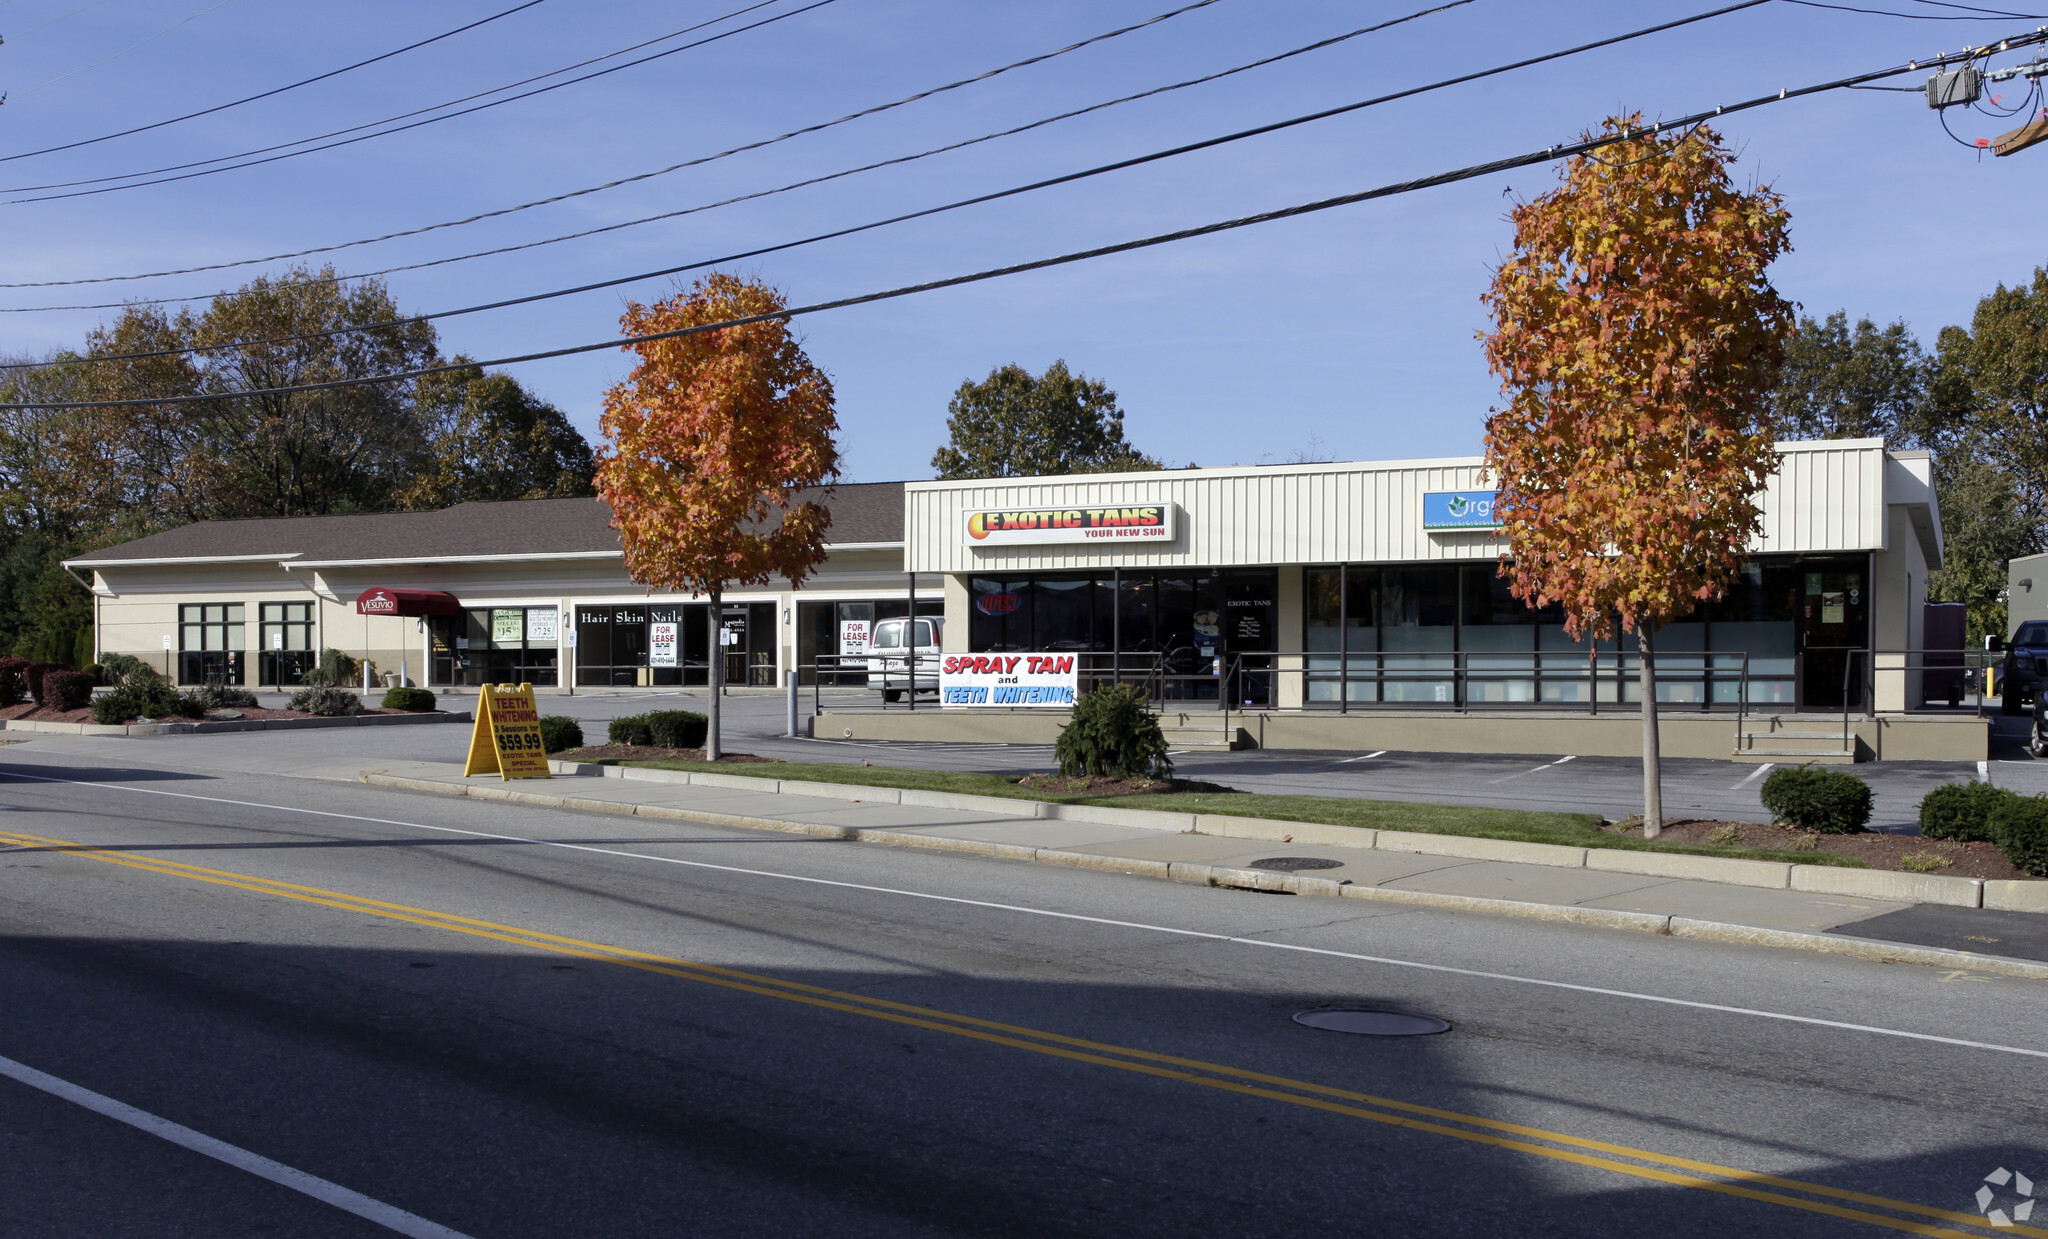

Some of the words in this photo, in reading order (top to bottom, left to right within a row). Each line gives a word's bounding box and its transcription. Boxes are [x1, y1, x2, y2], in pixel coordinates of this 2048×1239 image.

[1448, 496, 1495, 517] Org
[986, 510, 1082, 530] EXOTIC
[1087, 507, 1159, 527] TANS
[1084, 529, 1113, 538] YOUR
[1115, 528, 1140, 537] NEW
[1143, 527, 1165, 536] SUN
[361, 600, 394, 612] VESUVIO
[981, 594, 1018, 612] OPEN
[581, 612, 609, 623] Hair
[615, 610, 644, 623] Skin
[651, 610, 682, 622] Nails
[847, 623, 863, 631] FOR
[651, 634, 675, 642] LEASE
[842, 632, 868, 641] LEASE
[943, 656, 1021, 674] SPRAY
[1027, 656, 1074, 674] TAN
[998, 676, 1018, 684] and
[943, 686, 988, 703] TEETH
[993, 685, 1075, 704] WHITENING
[494, 697, 529, 709] TEETH
[491, 710, 538, 722] WHITENING
[501, 724, 528, 732] Sessions
[498, 733, 541, 751] $59.99
